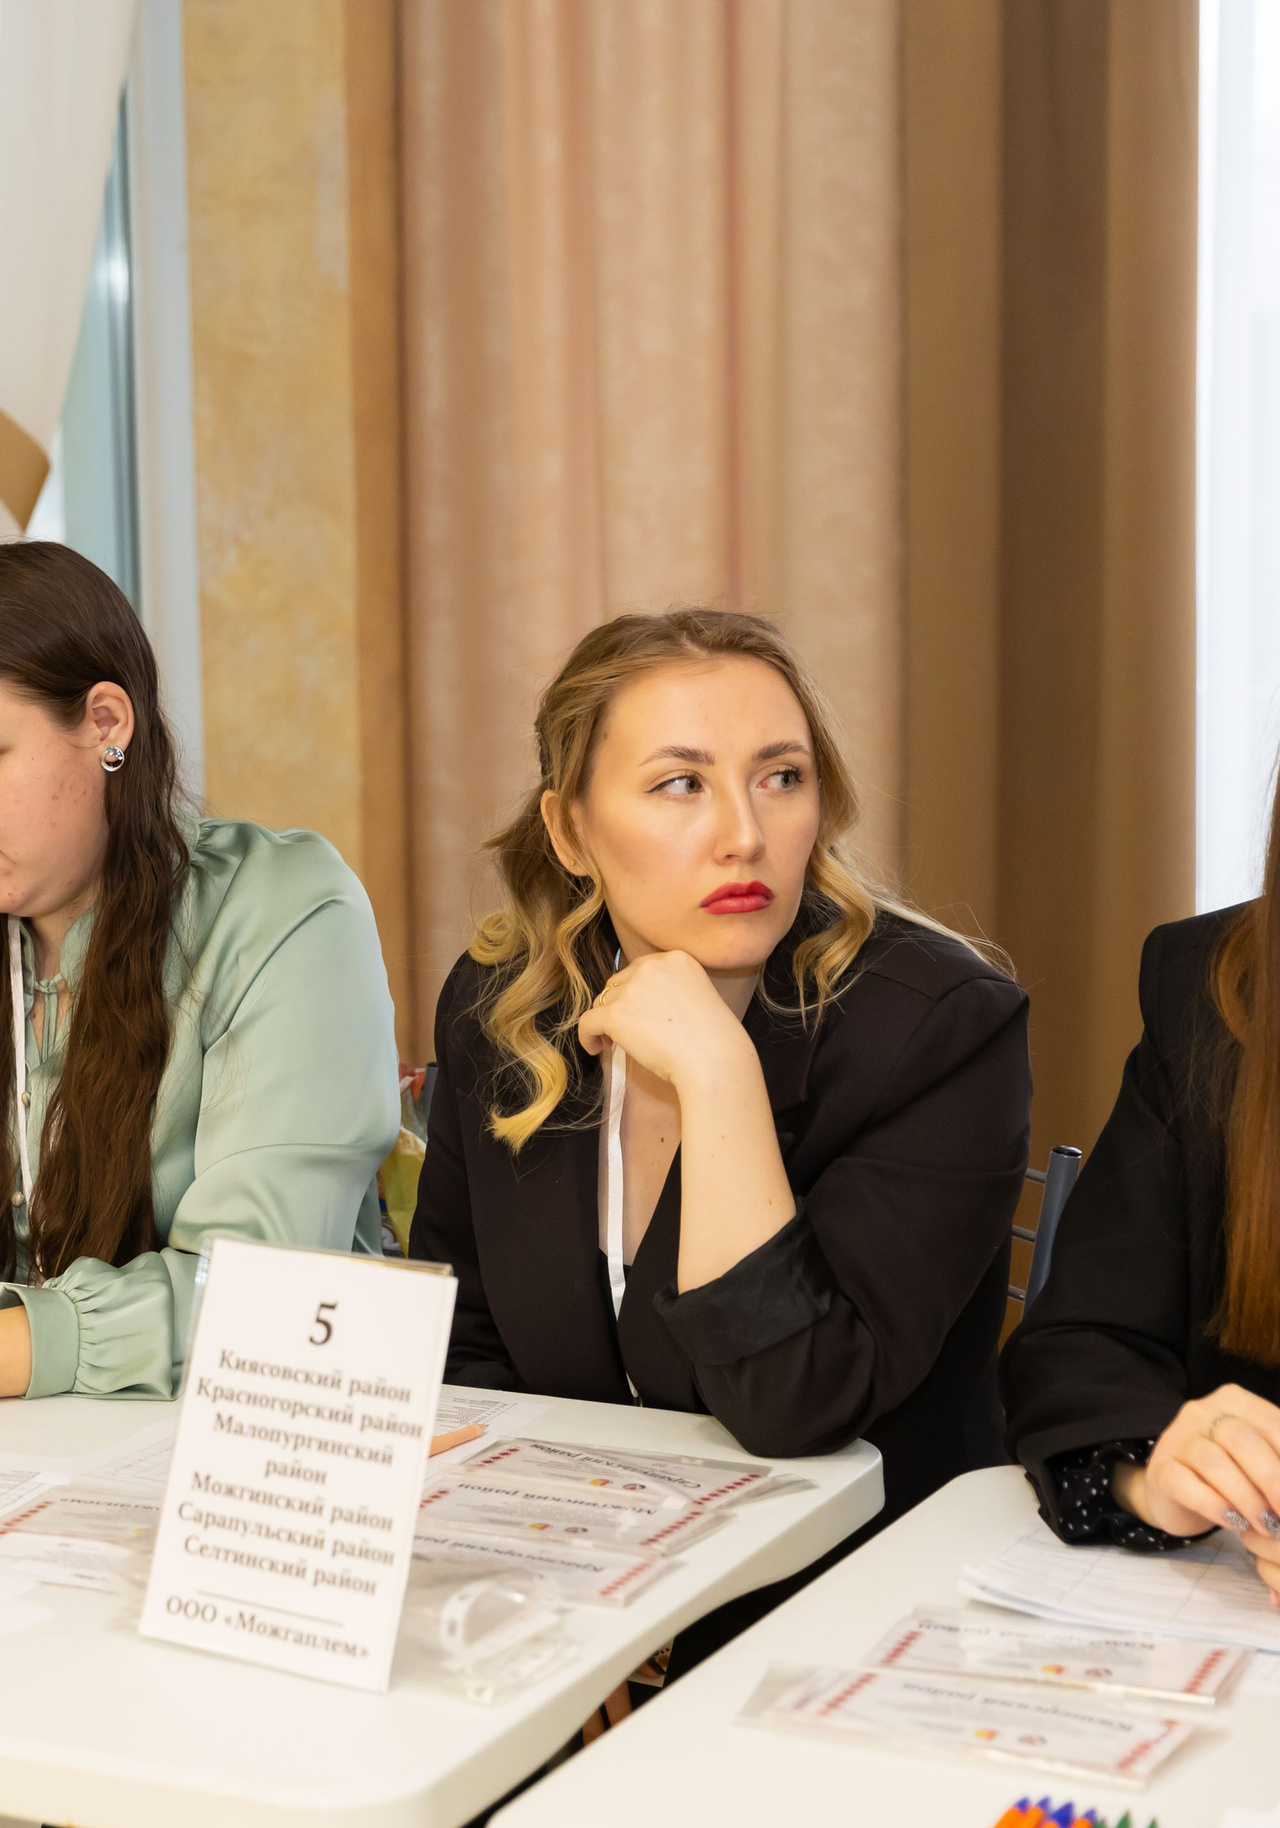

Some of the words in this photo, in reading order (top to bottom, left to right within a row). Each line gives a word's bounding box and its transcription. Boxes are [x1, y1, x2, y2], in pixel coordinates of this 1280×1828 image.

[308, 1300, 339, 1346] 5
[218, 1349, 343, 1390] Киясовский
[348, 1377, 412, 1403] район
[196, 1376, 354, 1425] Красногорский
[360, 1413, 424, 1439] район
[212, 1411, 394, 1466] Малопургинский
[190, 1470, 325, 1518] Можгинский
[330, 1505, 394, 1532] район
[264, 1459, 328, 1485] район
[177, 1500, 326, 1551] Сарапульский
[331, 1539, 396, 1566] район
[184, 1534, 308, 1580] Селтинский
[313, 1569, 378, 1596] район
[166, 1595, 218, 1623] ООО
[225, 1611, 370, 1659] «Можгаплем»
